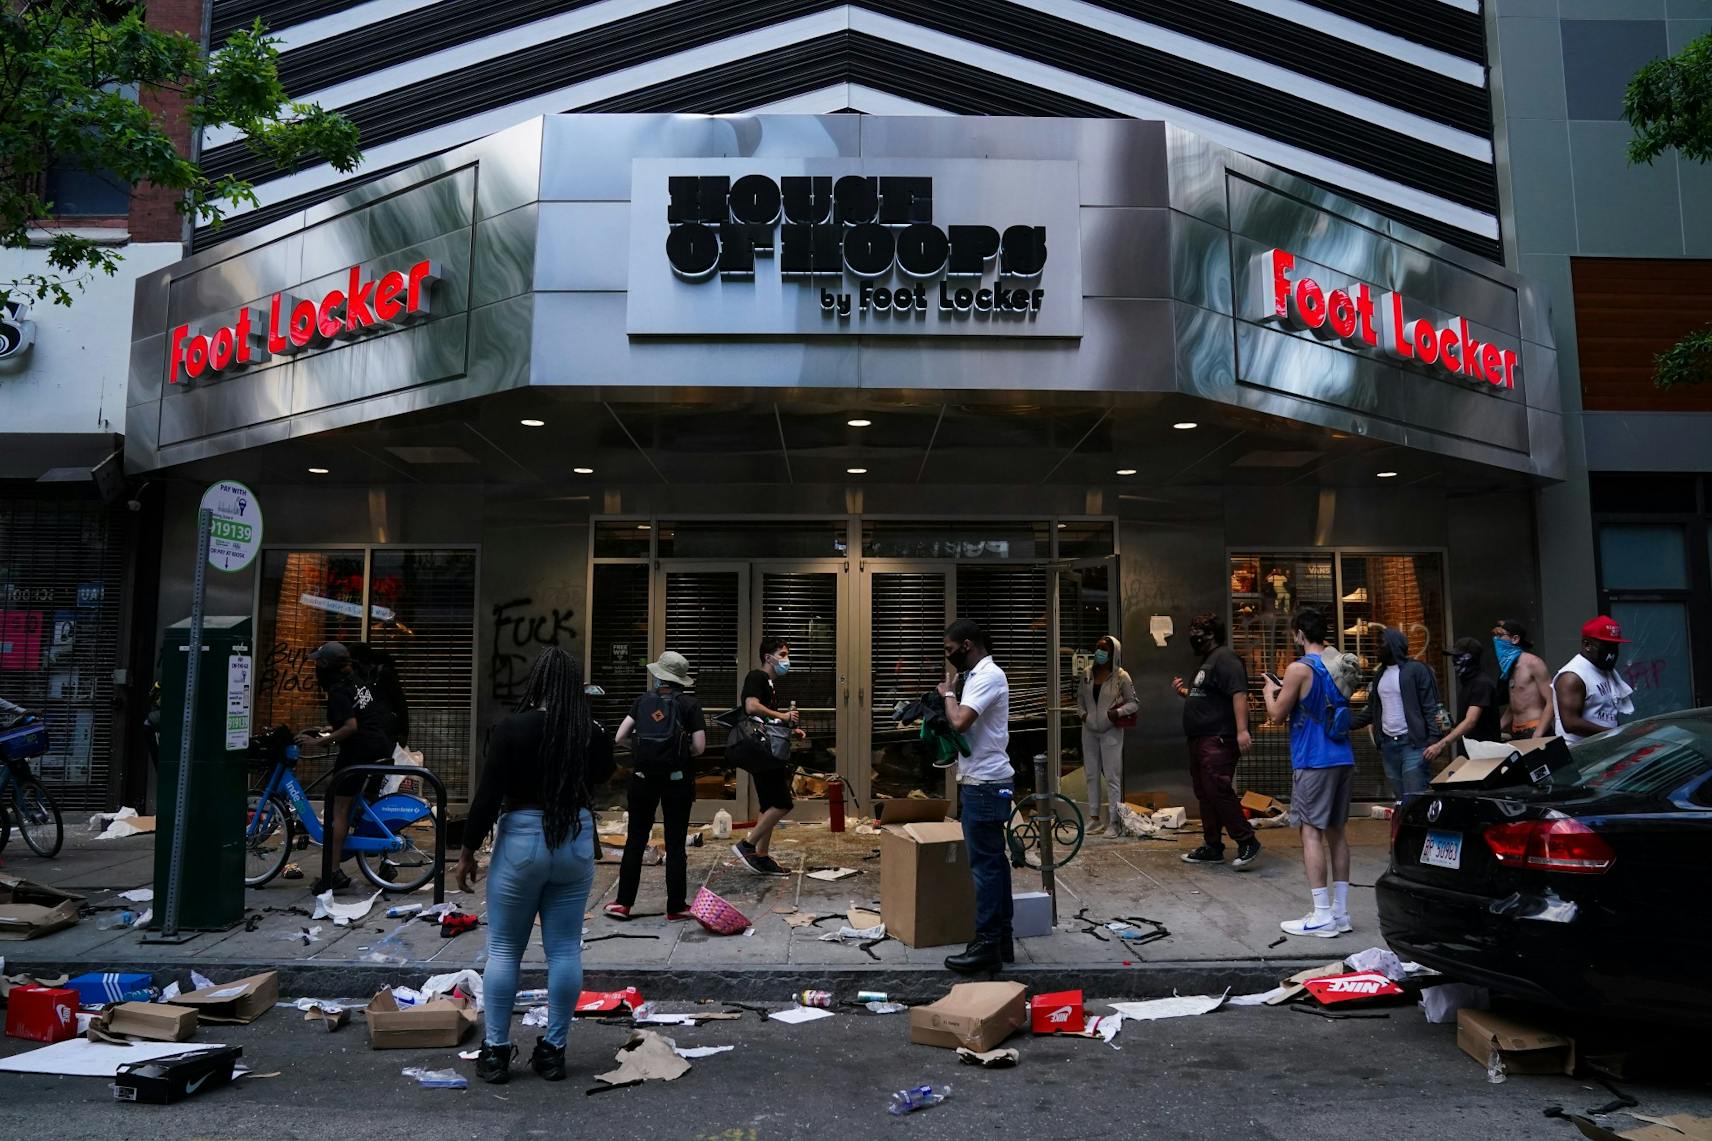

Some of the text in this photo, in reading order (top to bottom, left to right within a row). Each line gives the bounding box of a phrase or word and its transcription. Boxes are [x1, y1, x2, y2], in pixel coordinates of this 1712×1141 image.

[668, 174, 933, 227] HOUSE
[666, 223, 1048, 277] OF HOOPS
[170, 259, 430, 383] Foot Locker
[820, 281, 1045, 316] by Foot Locker
[1274, 248, 1518, 390] Foot Locker
[220, 484, 247, 496] PAY WITH
[493, 598, 577, 655] FUCK
[259, 669, 319, 697] Blac
[1326, 981, 1380, 994] NIKE
